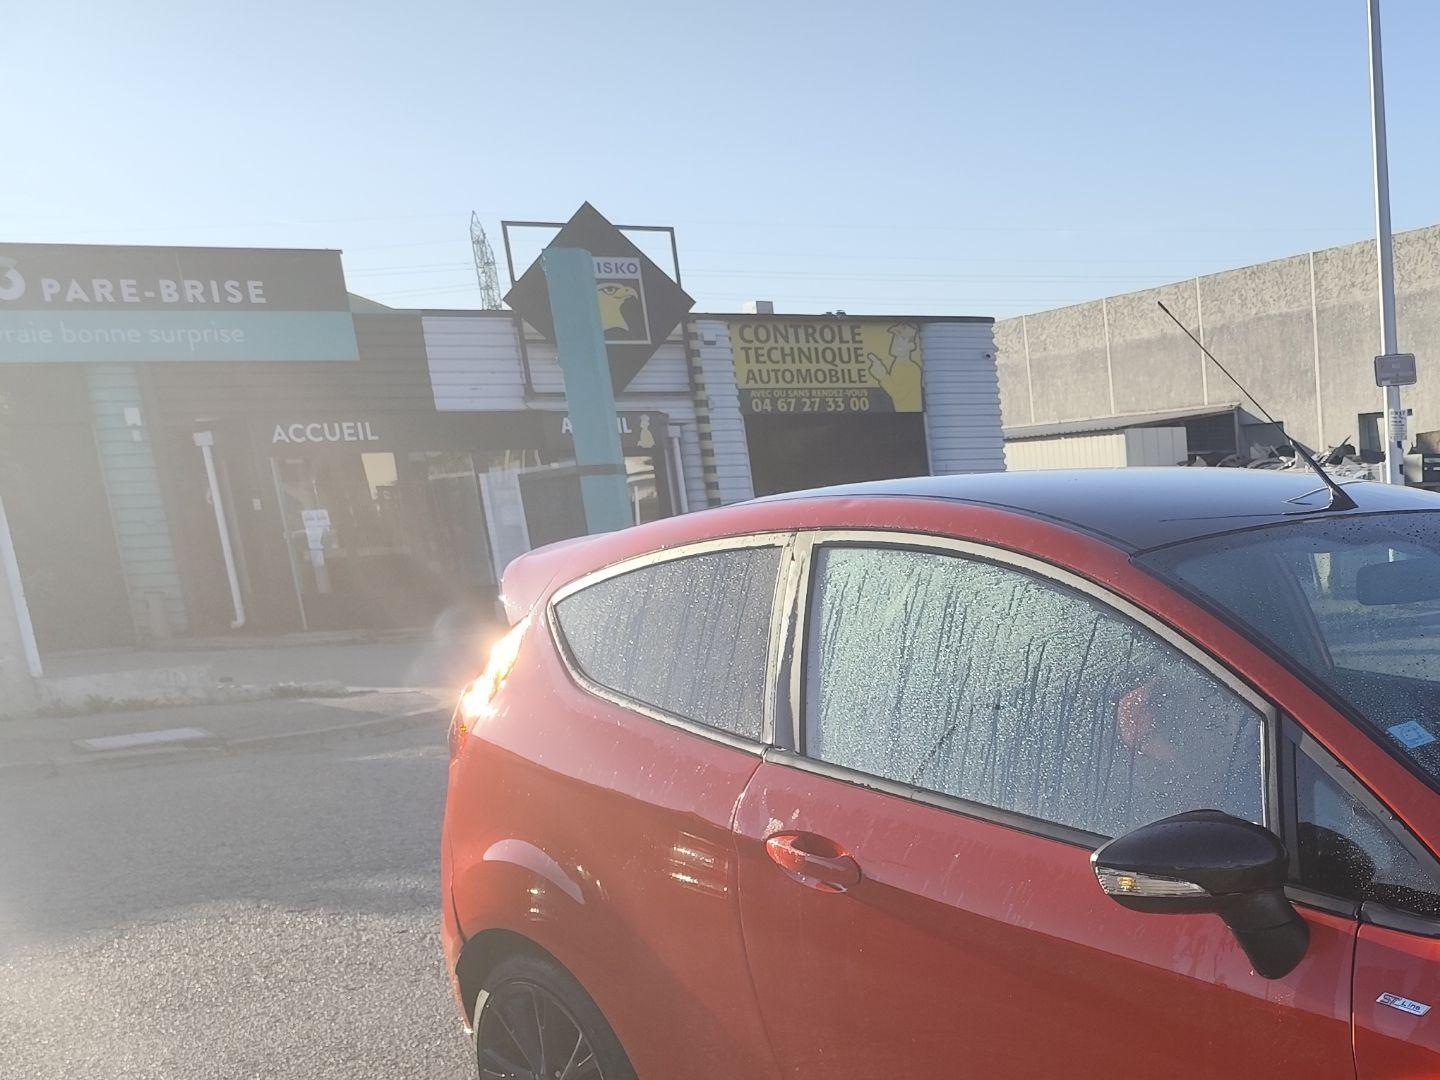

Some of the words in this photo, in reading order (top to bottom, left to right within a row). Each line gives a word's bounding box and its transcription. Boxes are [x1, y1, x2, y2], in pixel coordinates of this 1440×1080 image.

[40, 278, 267, 304] PARE-BRISE
[0, 321, 53, 344] raie
[60, 321, 141, 344] bonne
[150, 322, 246, 352] surprise
[738, 324, 863, 344] CONTROLE
[740, 346, 866, 367] TECHNIQUE
[745, 368, 869, 385] AUTOMOBILE
[751, 389, 772, 398] AVEC
[773, 389, 786, 398] OU
[788, 389, 810, 398] SANS
[751, 398, 772, 412] 04
[777, 398, 796, 412] 67
[801, 398, 820, 412] 27
[825, 398, 845, 412] 33
[850, 397, 870, 411] 00
[272, 422, 379, 443] ACCUEIL
